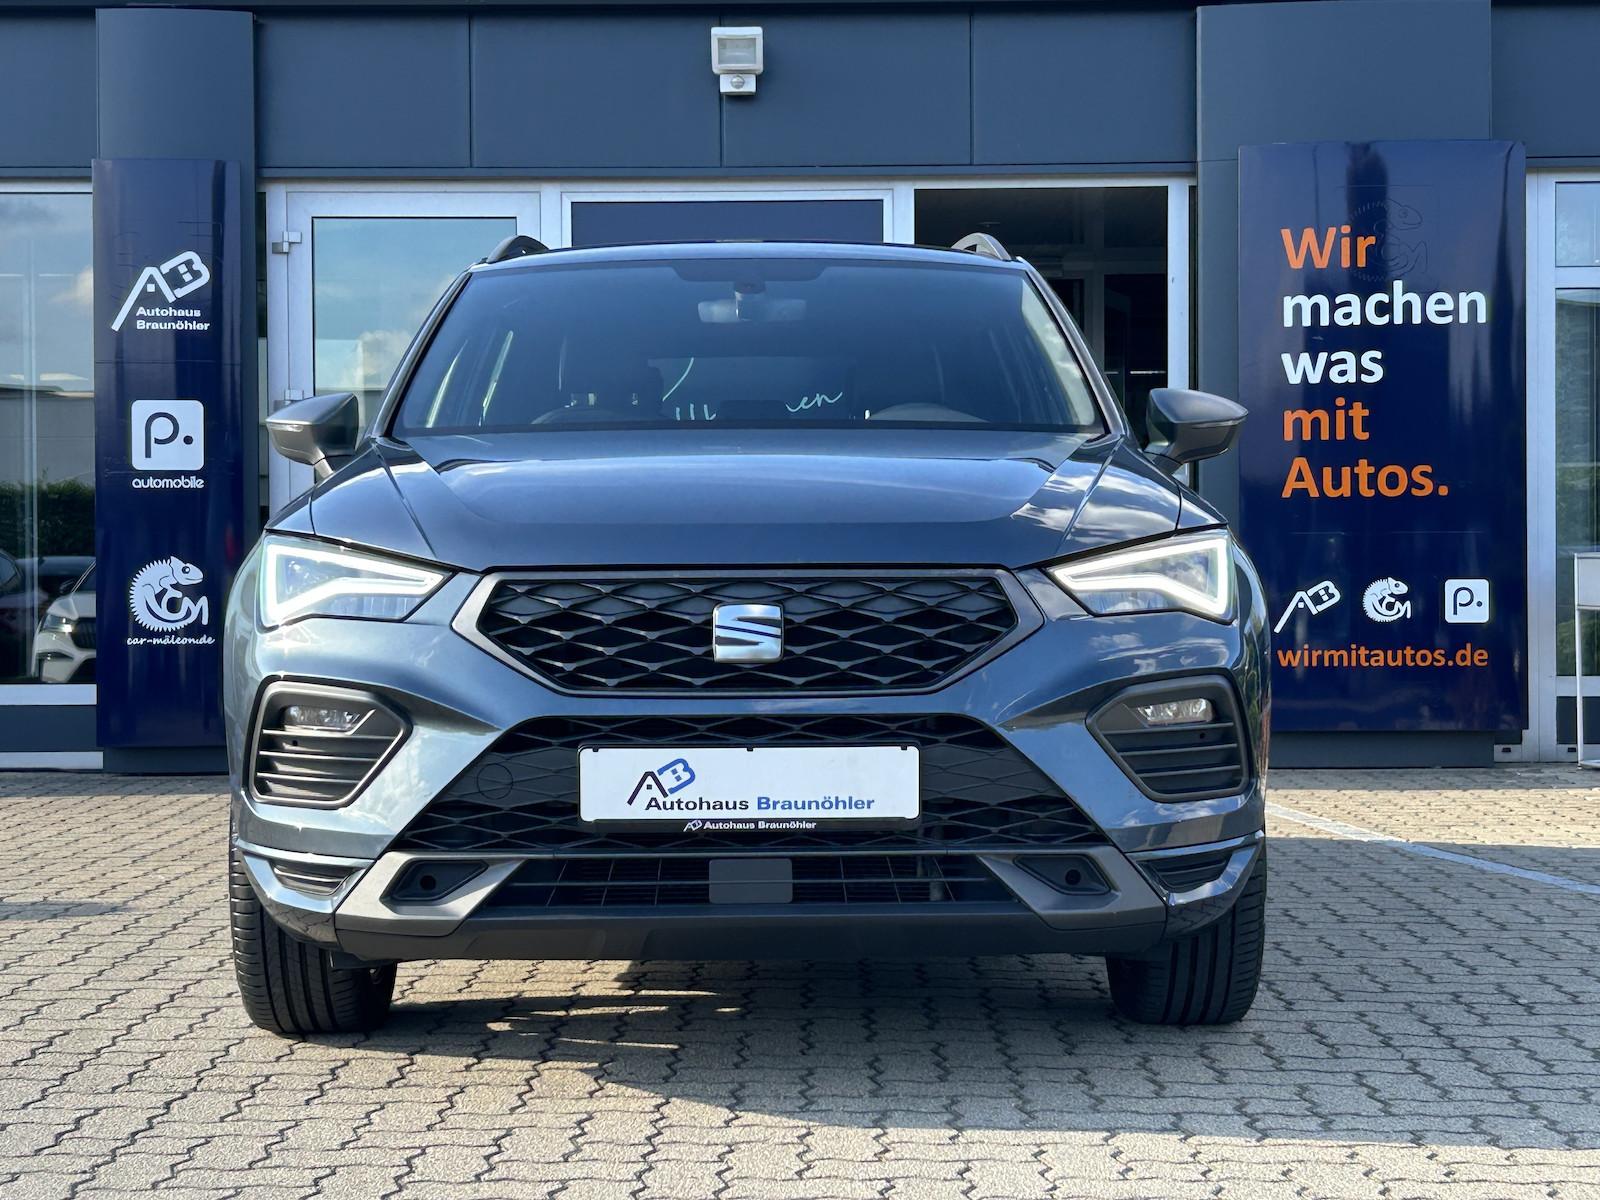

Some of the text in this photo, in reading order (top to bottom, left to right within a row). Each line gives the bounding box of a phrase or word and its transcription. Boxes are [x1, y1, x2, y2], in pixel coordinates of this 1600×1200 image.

[1281, 225, 1377, 270] Wir
[136, 306, 201, 317] Autohaus
[1283, 280, 1487, 327] machen
[136, 319, 211, 331] Braunöhler
[1282, 349, 1384, 384] was
[1283, 397, 1370, 441] mit
[132, 475, 205, 489] automobile
[1282, 457, 1449, 498] Autos.
[1277, 643, 1489, 668] wirmitautos.de
[644, 795, 876, 811] Autohaus Braunöhler
[703, 821, 756, 830] Autohaus
[758, 820, 817, 830] Braunöhler
